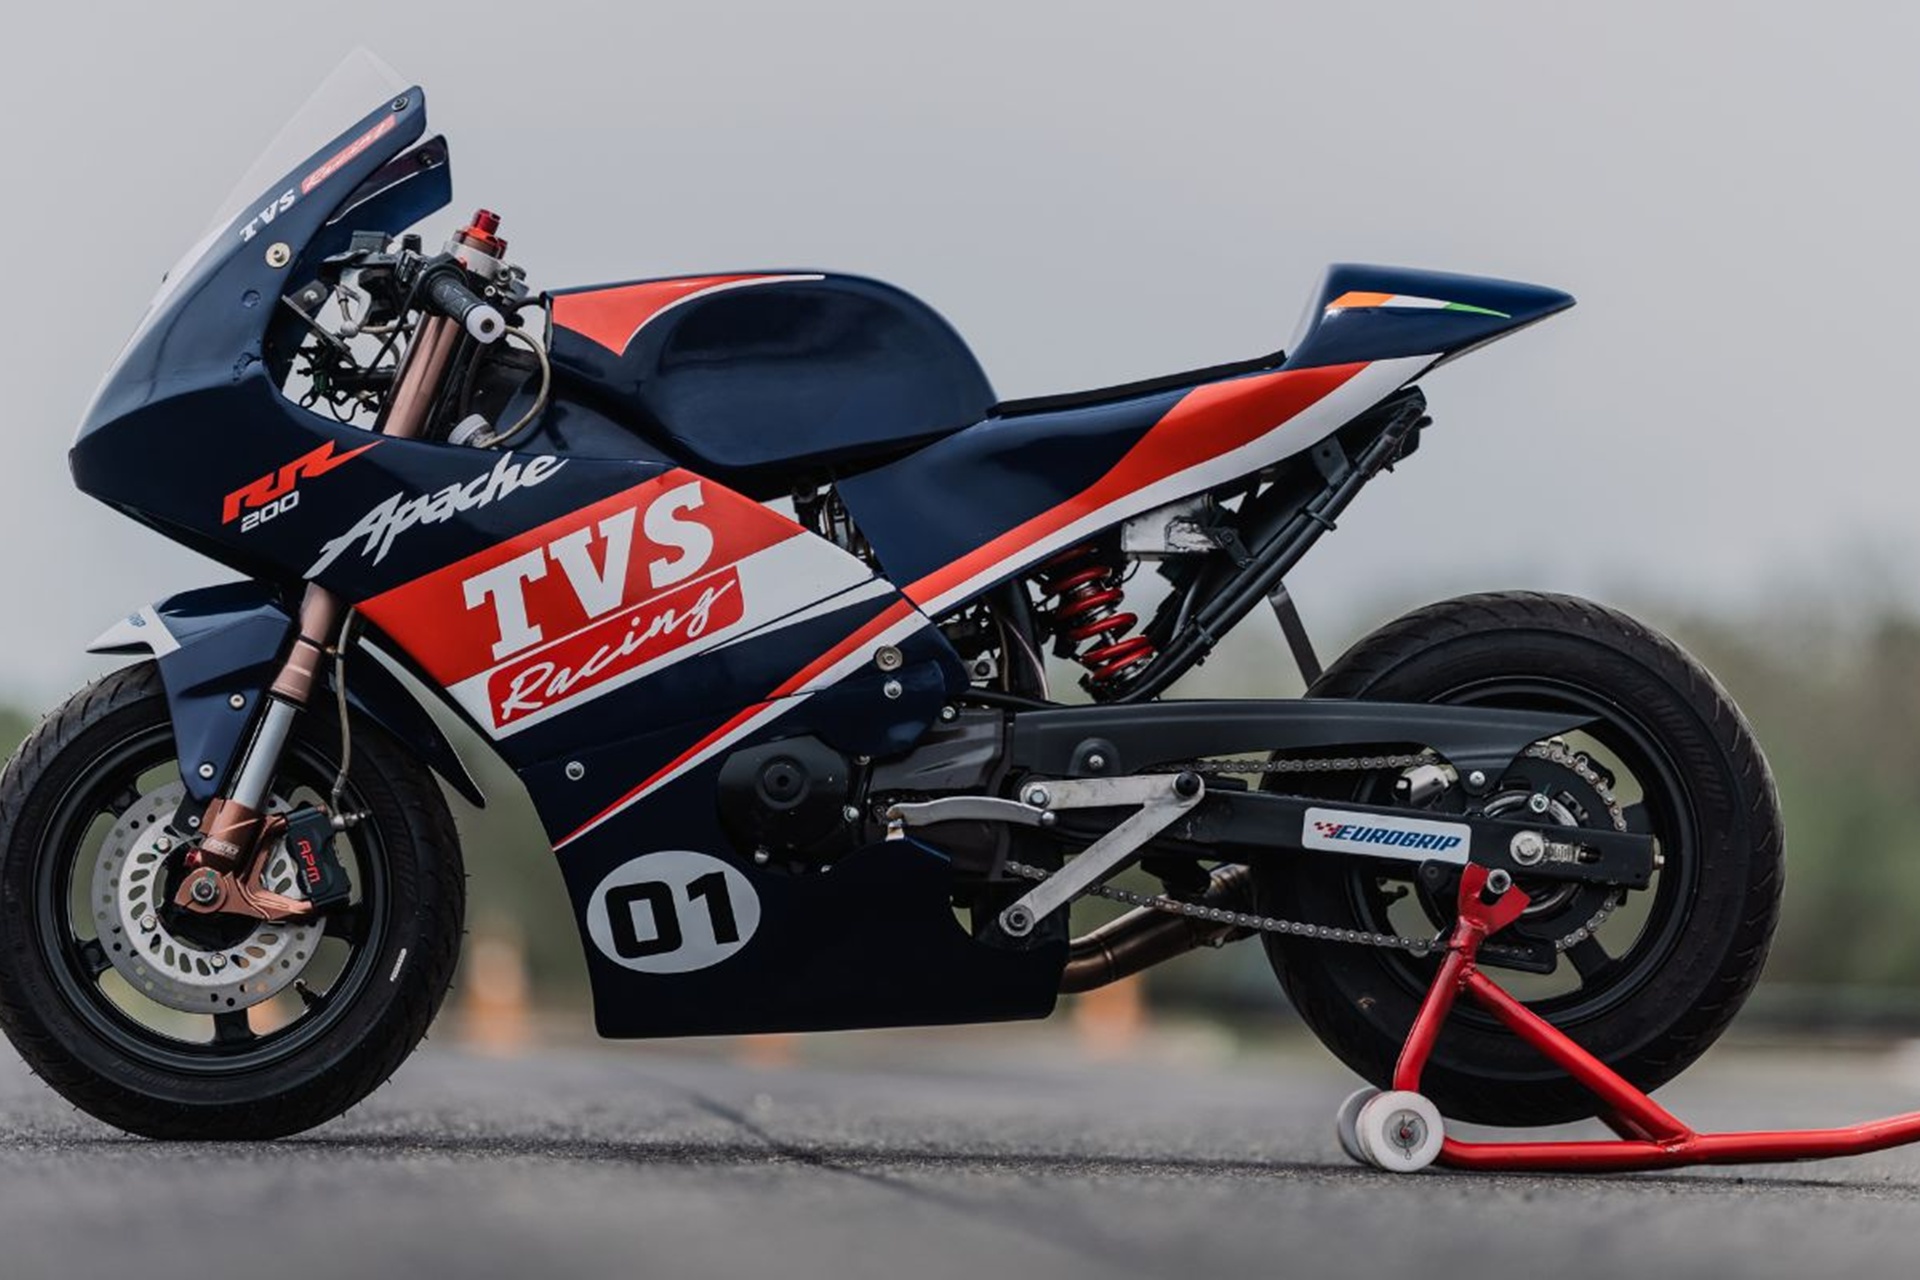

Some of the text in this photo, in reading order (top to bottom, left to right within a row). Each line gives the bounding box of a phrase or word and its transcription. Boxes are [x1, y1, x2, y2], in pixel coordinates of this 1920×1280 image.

[239, 189, 296, 242] TVS
[240, 490, 300, 534] 200
[302, 450, 570, 580] Apache
[461, 480, 715, 662] TVS
[501, 578, 737, 721] Racing
[1334, 824, 1462, 851] EUROGRIP
[604, 871, 740, 960] 01
